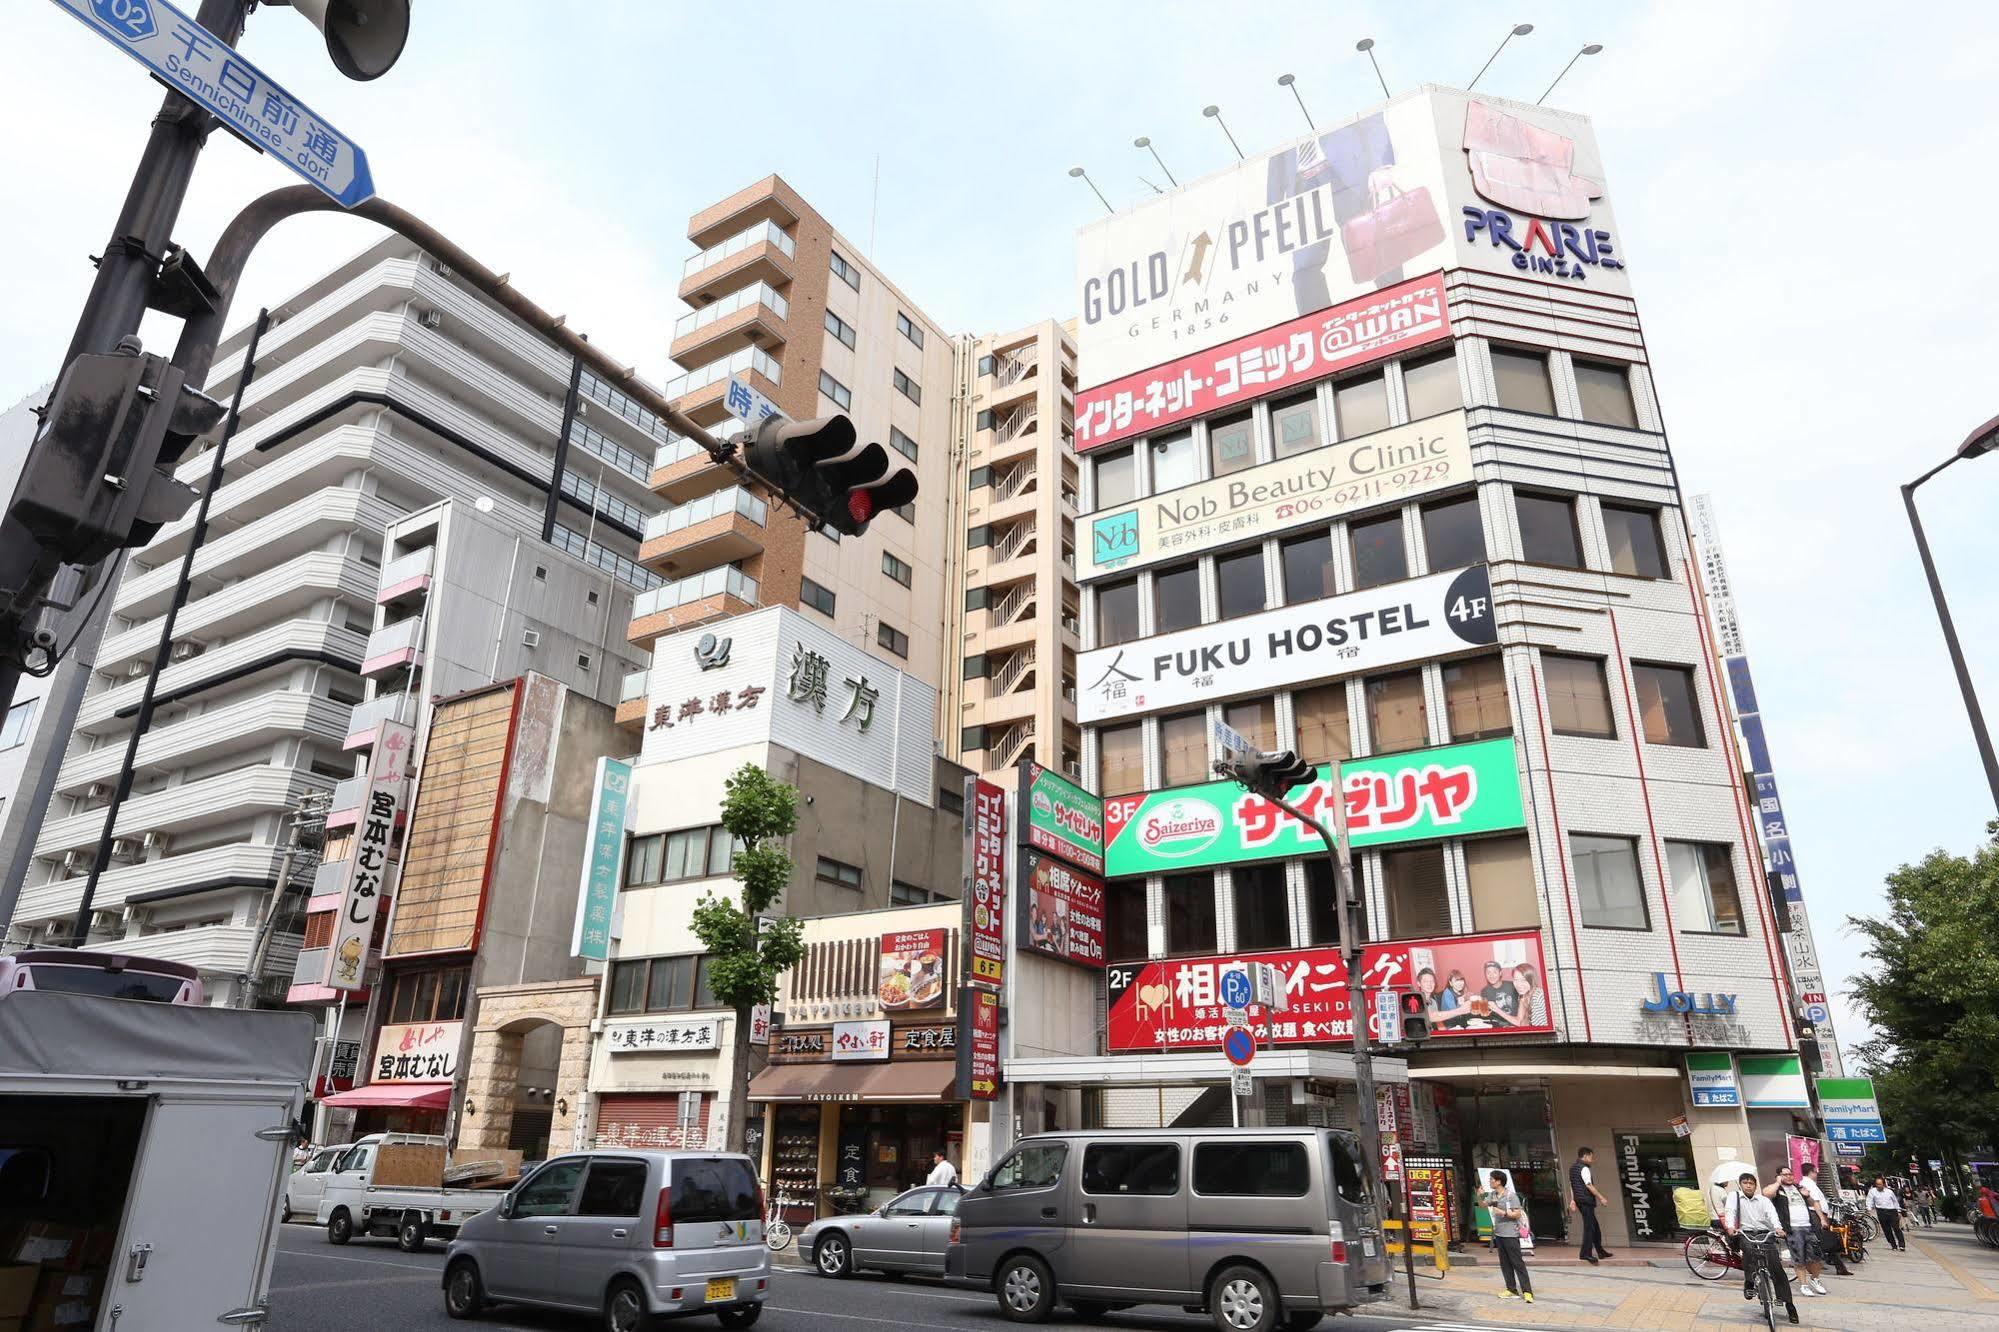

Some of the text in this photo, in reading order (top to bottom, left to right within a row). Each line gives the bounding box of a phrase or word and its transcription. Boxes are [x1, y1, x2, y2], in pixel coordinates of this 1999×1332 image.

[170, 24, 340, 167] 千日前通
[165, 54, 282, 148] Sennichimae
[297, 150, 330, 181] dori
[1083, 189, 1334, 325] GOLD PFEIL
[1511, 252, 1586, 280] GINZA
[1128, 272, 1283, 338] GERMANY
[1172, 314, 1229, 340] 1856
[1074, 331, 1316, 442] インターネット・コミック
[1157, 436, 1449, 530] Nob Beauty Clinic
[1295, 461, 1450, 515] 06-6211-9229
[1449, 595, 1487, 624] 4F
[1153, 604, 1430, 681] FUKU HOSTEL
[786, 641, 880, 734] 漢方
[648, 684, 766, 731] 東洋漢方
[1107, 799, 1136, 823] 3F
[1238, 772, 1471, 842] サイゼリヤ
[976, 794, 988, 876] コミック
[1144, 817, 1216, 844] Saizeriya
[349, 790, 396, 924] 宮本むなし
[989, 793, 1001, 932] インターネット
[1109, 970, 1133, 989] 2F
[1228, 978, 1239, 1003] P
[1643, 972, 1737, 1014] JOLLY
[1808, 994, 1822, 1003] IN
[622, 1026, 712, 1048] 東洋の漢方薬
[837, 1030, 885, 1050] やよい軒
[904, 1027, 956, 1049] 定食屋
[378, 1053, 456, 1080] 宮本むなし
[1691, 1073, 1733, 1083] FamilyMart
[806, 1093, 859, 1101] YAYOIKEN
[1712, 1093, 1736, 1103] たばこ
[1823, 1104, 1876, 1114] FamilyMart
[1832, 1127, 1879, 1139] 酒 たばこ
[843, 1145, 861, 1184] 定食
[1622, 1135, 1653, 1236] FamilyMart
